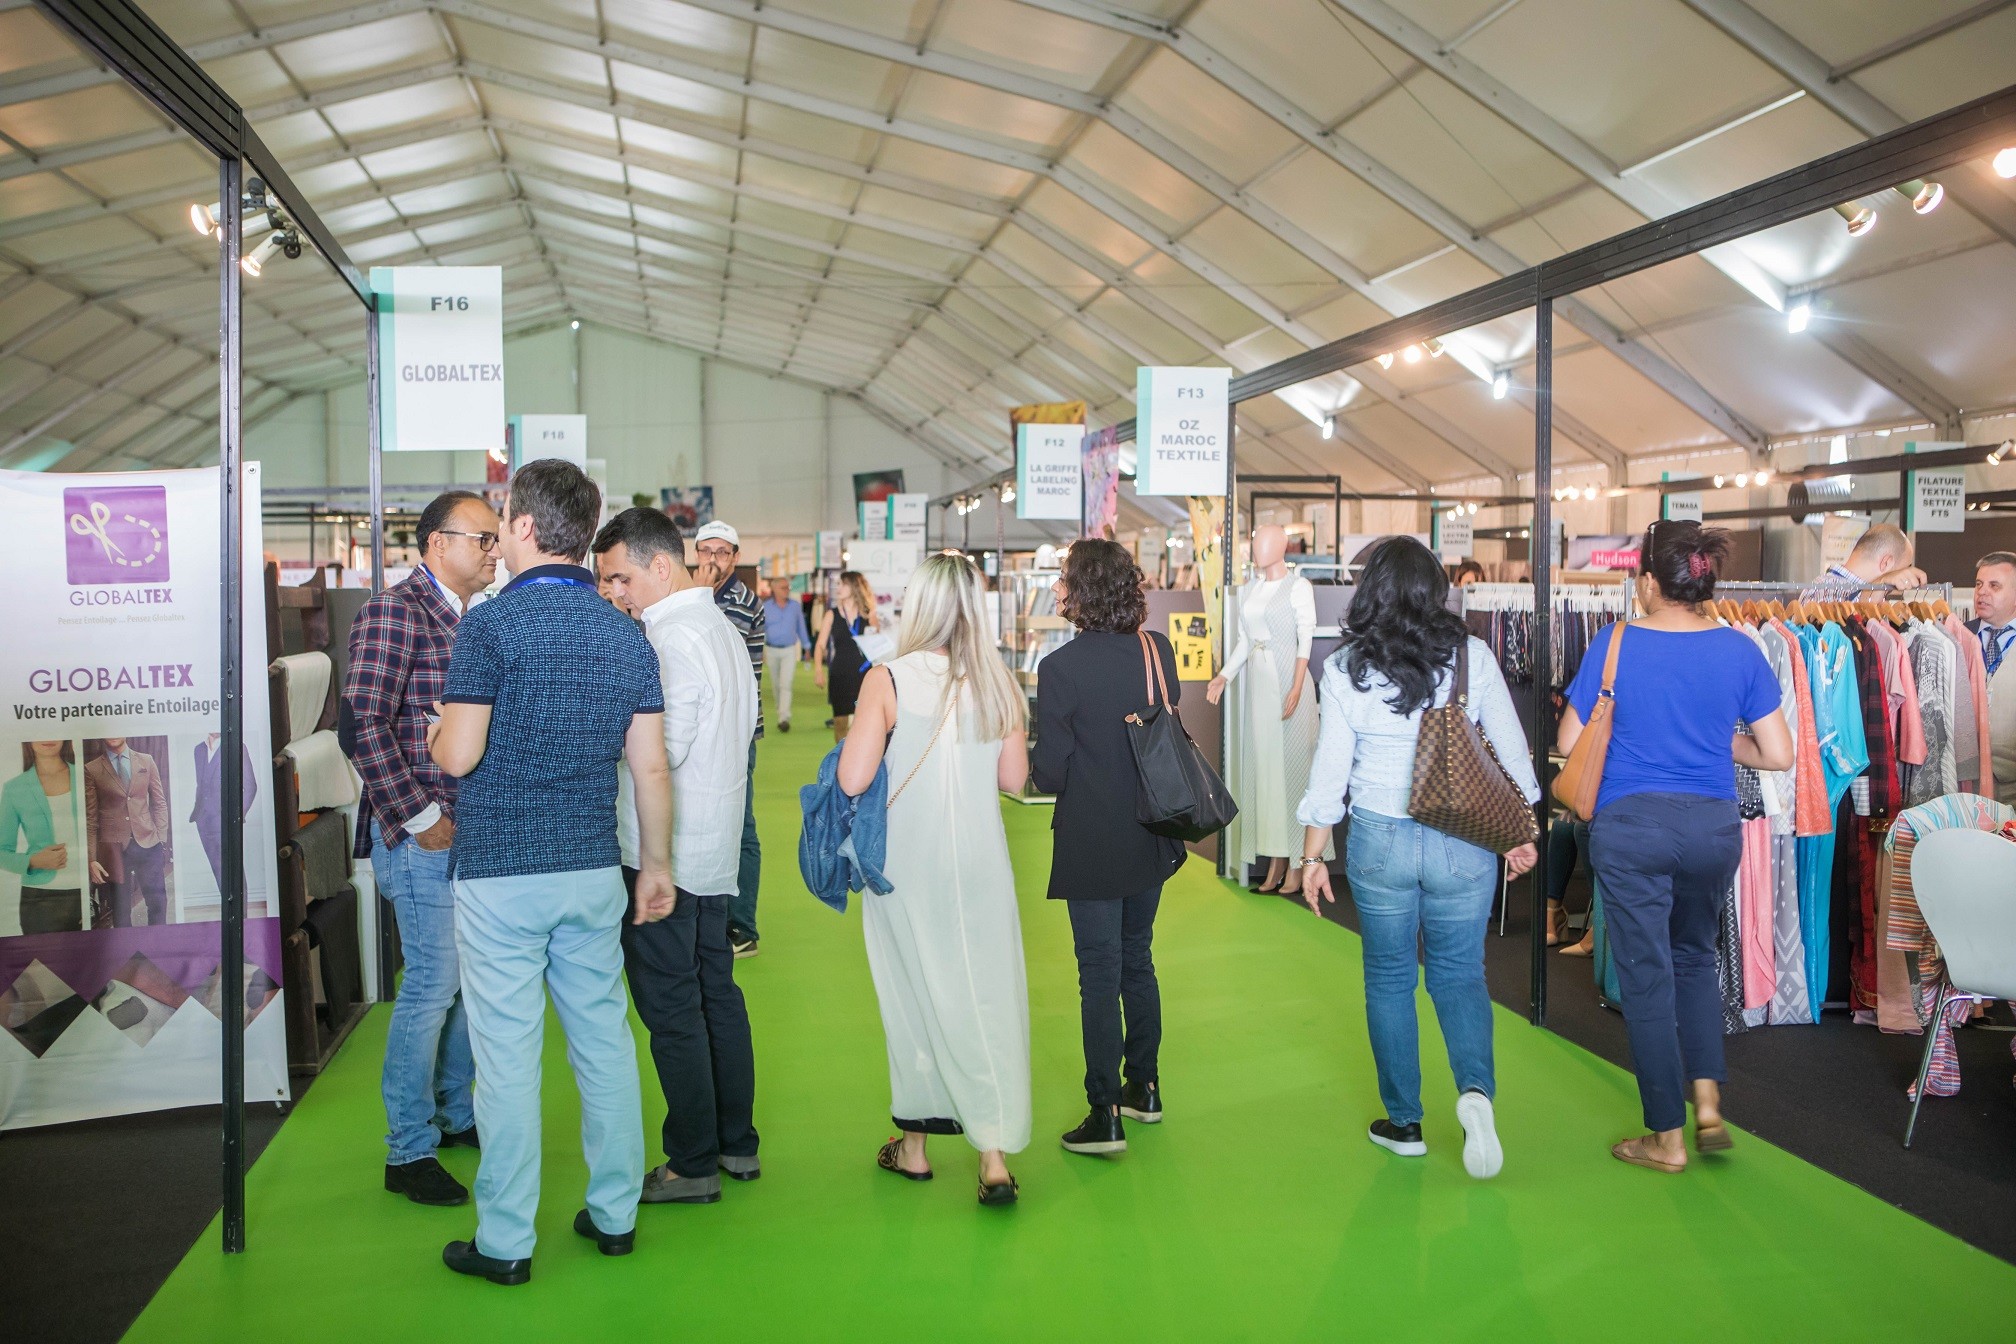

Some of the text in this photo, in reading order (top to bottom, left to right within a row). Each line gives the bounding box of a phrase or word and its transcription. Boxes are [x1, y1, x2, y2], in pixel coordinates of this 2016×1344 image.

[431, 296, 469, 311] F16
[402, 364, 502, 382] GLOBALTEX
[1177, 388, 1204, 398] F13
[1179, 420, 1200, 430] OZ
[1045, 438, 1065, 447] F12
[1161, 435, 1216, 446] MAROC
[1157, 450, 1221, 461] TEXTILE
[1030, 464, 1078, 474] LA GRIFFE
[1030, 476, 1077, 485] LABELING
[1918, 477, 1963, 485] FILATURE
[1037, 487, 1071, 495] MAROC
[1921, 488, 1960, 497] TEXTILE
[1923, 499, 1958, 508] SETTAT
[1931, 509, 1949, 518] FTS
[1596, 553, 1636, 565] Hudson
[69, 588, 173, 606] GLOBALTEX
[152, 613, 185, 622] Globaltex
[29, 664, 194, 694] GLOBALTEX
[13, 698, 220, 721] Votre partenaire Entoilage
